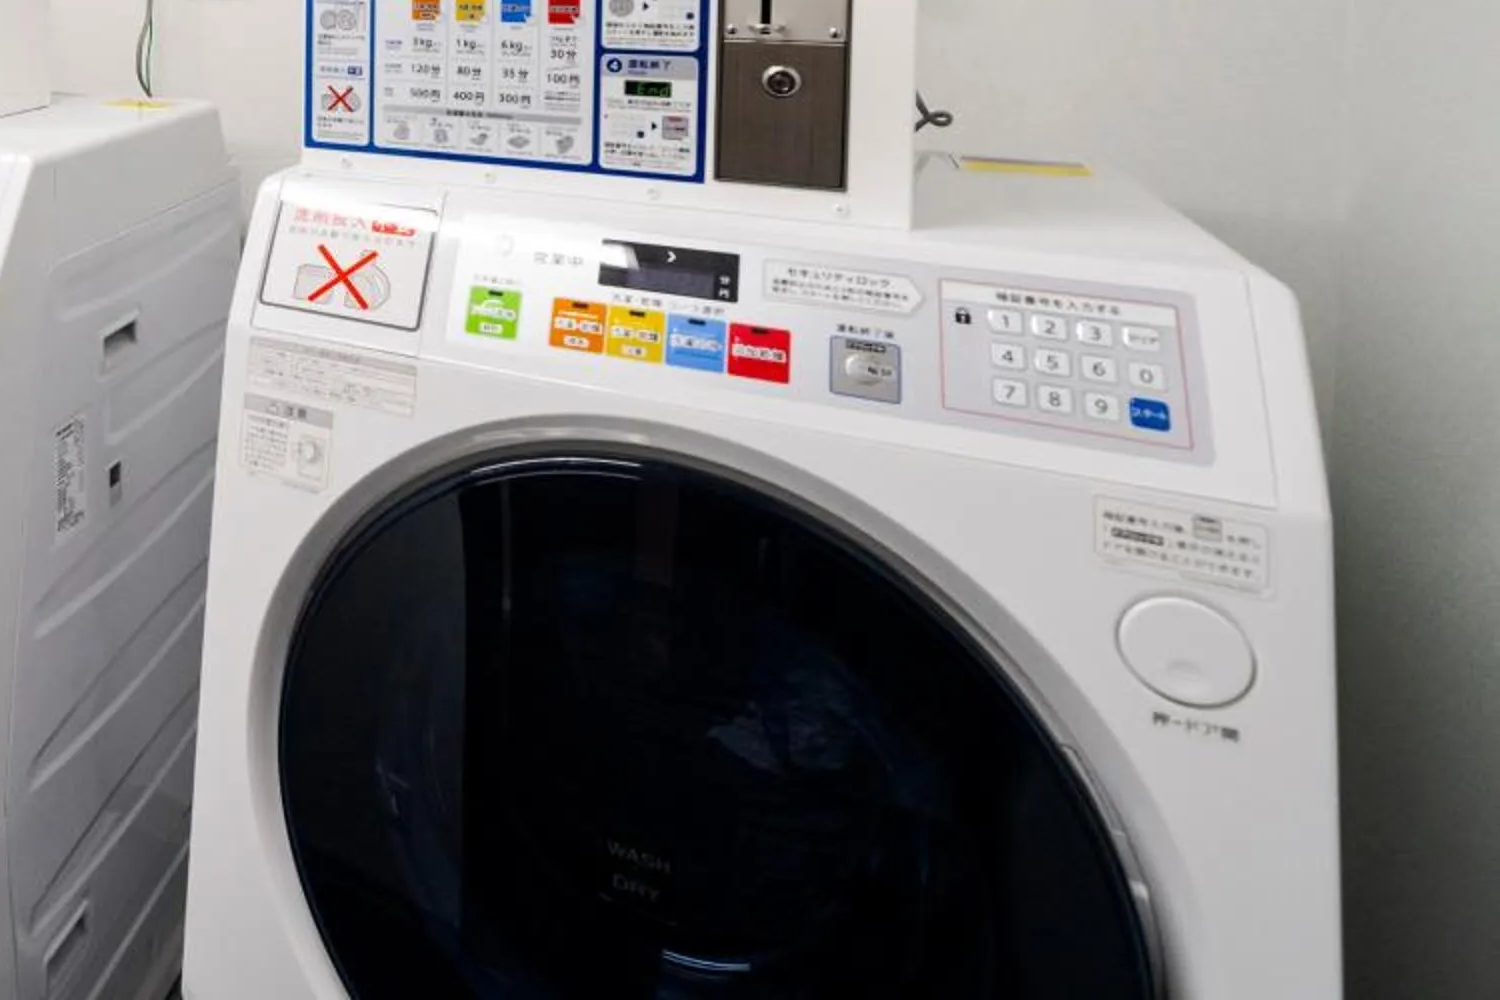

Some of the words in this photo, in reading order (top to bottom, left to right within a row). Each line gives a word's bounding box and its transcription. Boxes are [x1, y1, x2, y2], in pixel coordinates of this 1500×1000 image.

[1002, 314, 1010, 329] 1
[1045, 321, 1056, 335] 2
[1091, 326, 1101, 341] 3
[1002, 350, 1013, 363] 4
[1047, 356, 1059, 371] 5
[1093, 361, 1106, 377] 6
[1139, 368, 1154, 384] 0
[1004, 385, 1016, 399] 7
[1050, 391, 1062, 407] 8
[1094, 398, 1109, 414] 9
